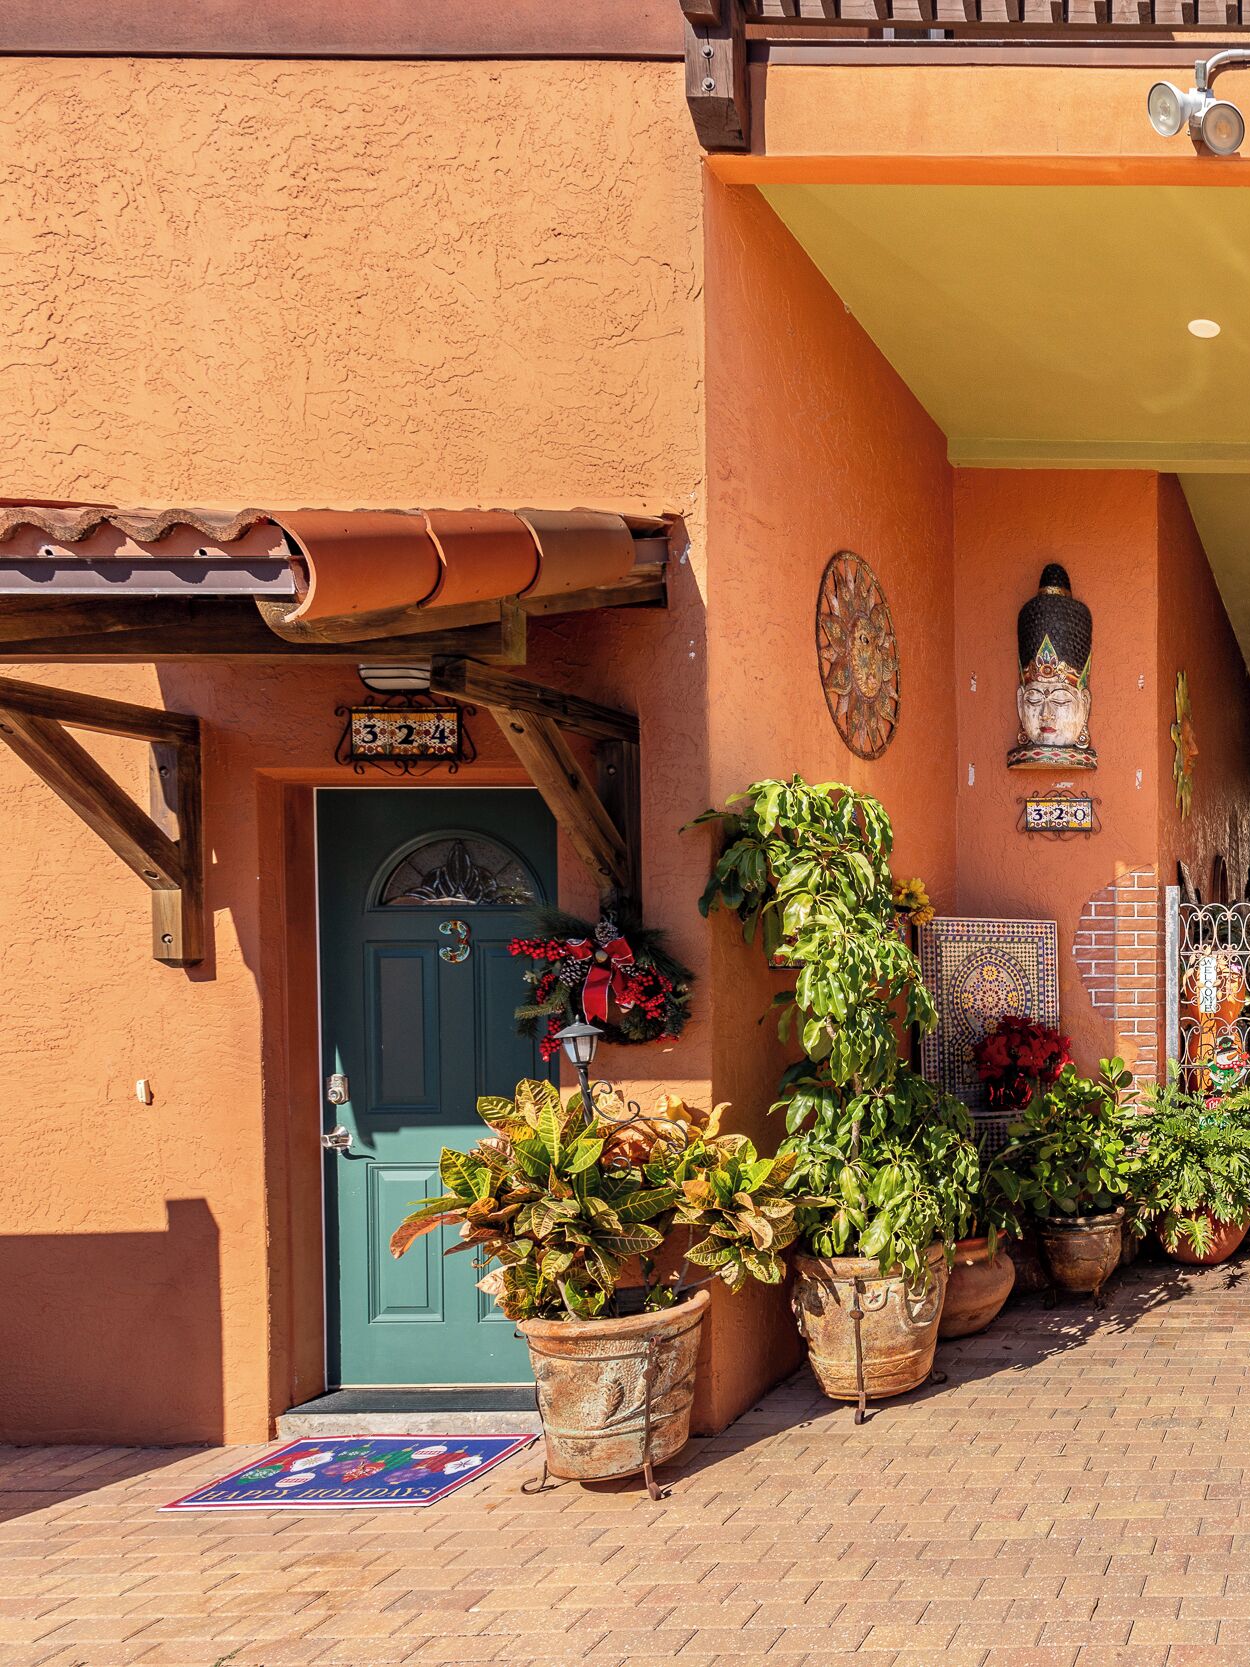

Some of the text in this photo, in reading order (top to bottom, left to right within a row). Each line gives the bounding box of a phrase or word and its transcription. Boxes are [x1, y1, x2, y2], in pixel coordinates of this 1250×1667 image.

[361, 723, 448, 745] 324
[1032, 807, 1086, 821] 320
[438, 919, 471, 965] 3
[1201, 959, 1213, 1012] WELCOME
[197, 1486, 437, 1501] HAPPY HOLIDAYS
